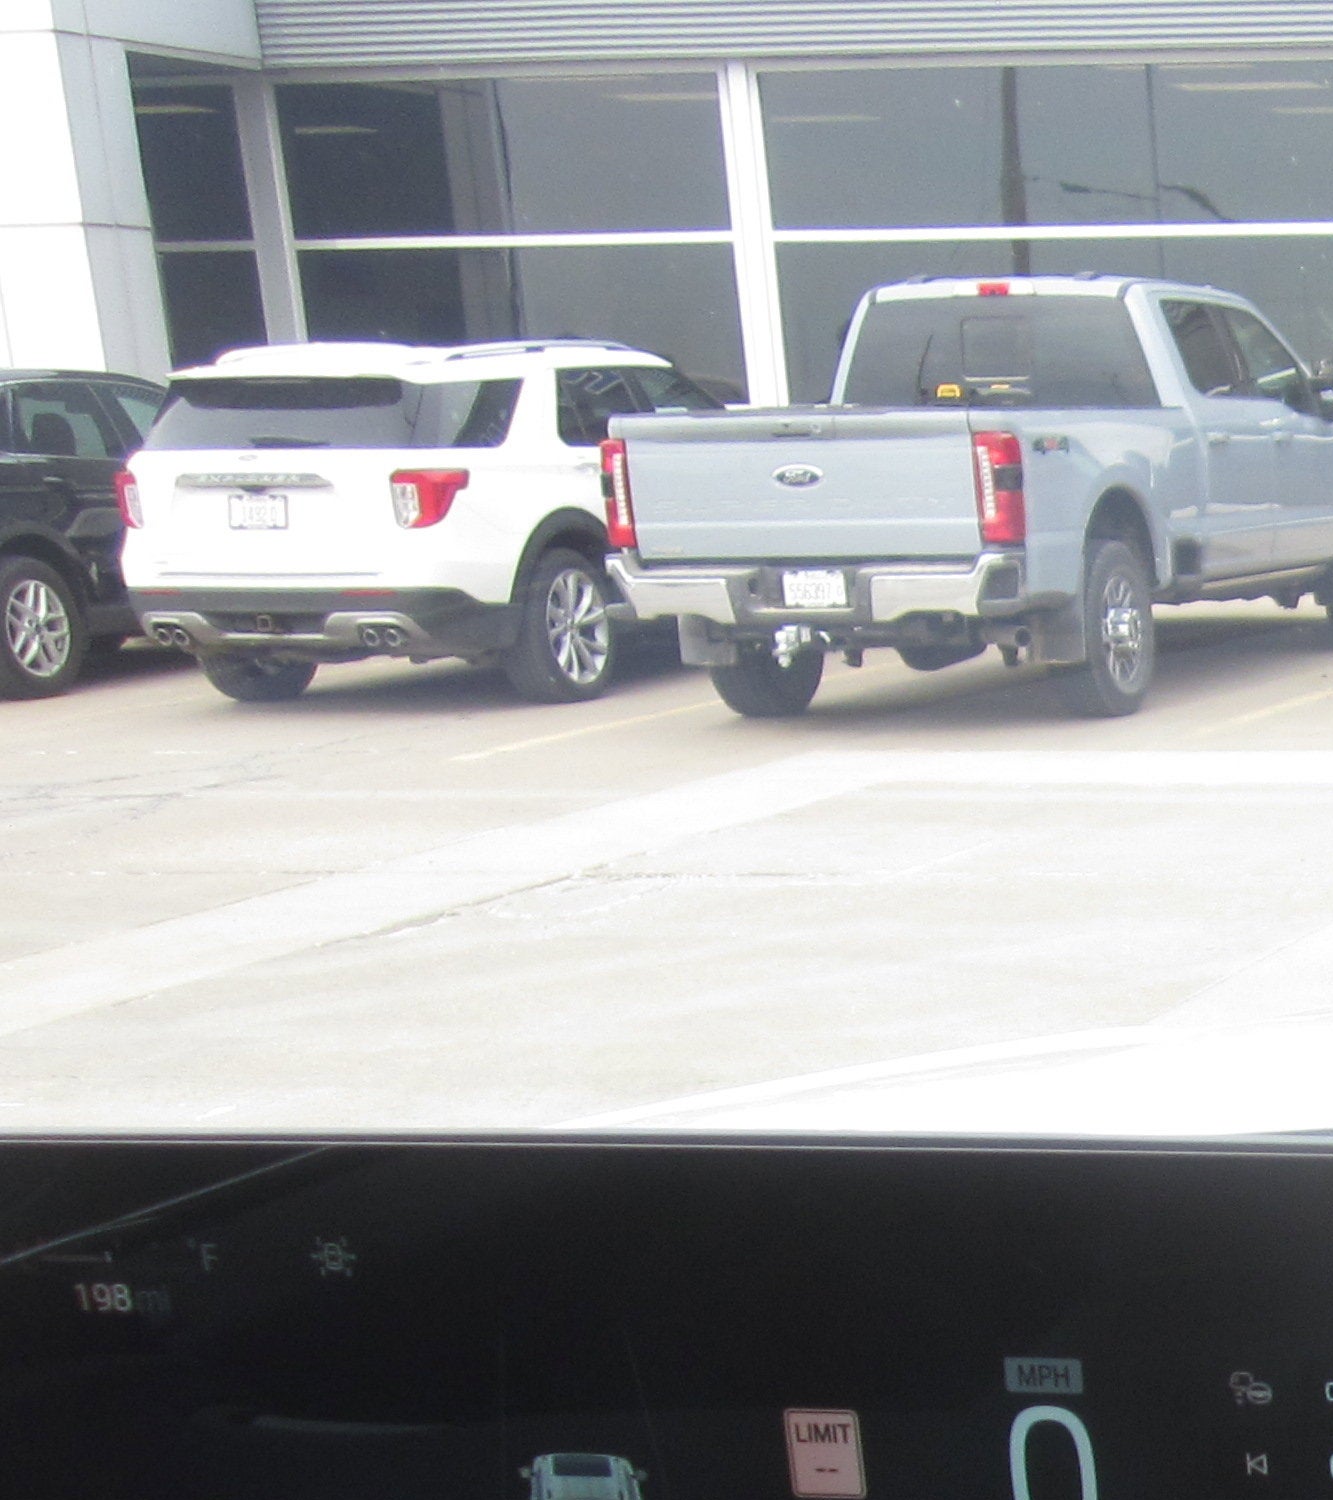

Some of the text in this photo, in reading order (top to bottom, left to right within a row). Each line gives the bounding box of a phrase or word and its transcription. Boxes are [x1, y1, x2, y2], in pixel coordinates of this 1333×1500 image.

[73, 1281, 133, 1313] 198
[1017, 1364, 1071, 1389] MPH
[794, 1421, 852, 1446] LIMIT
